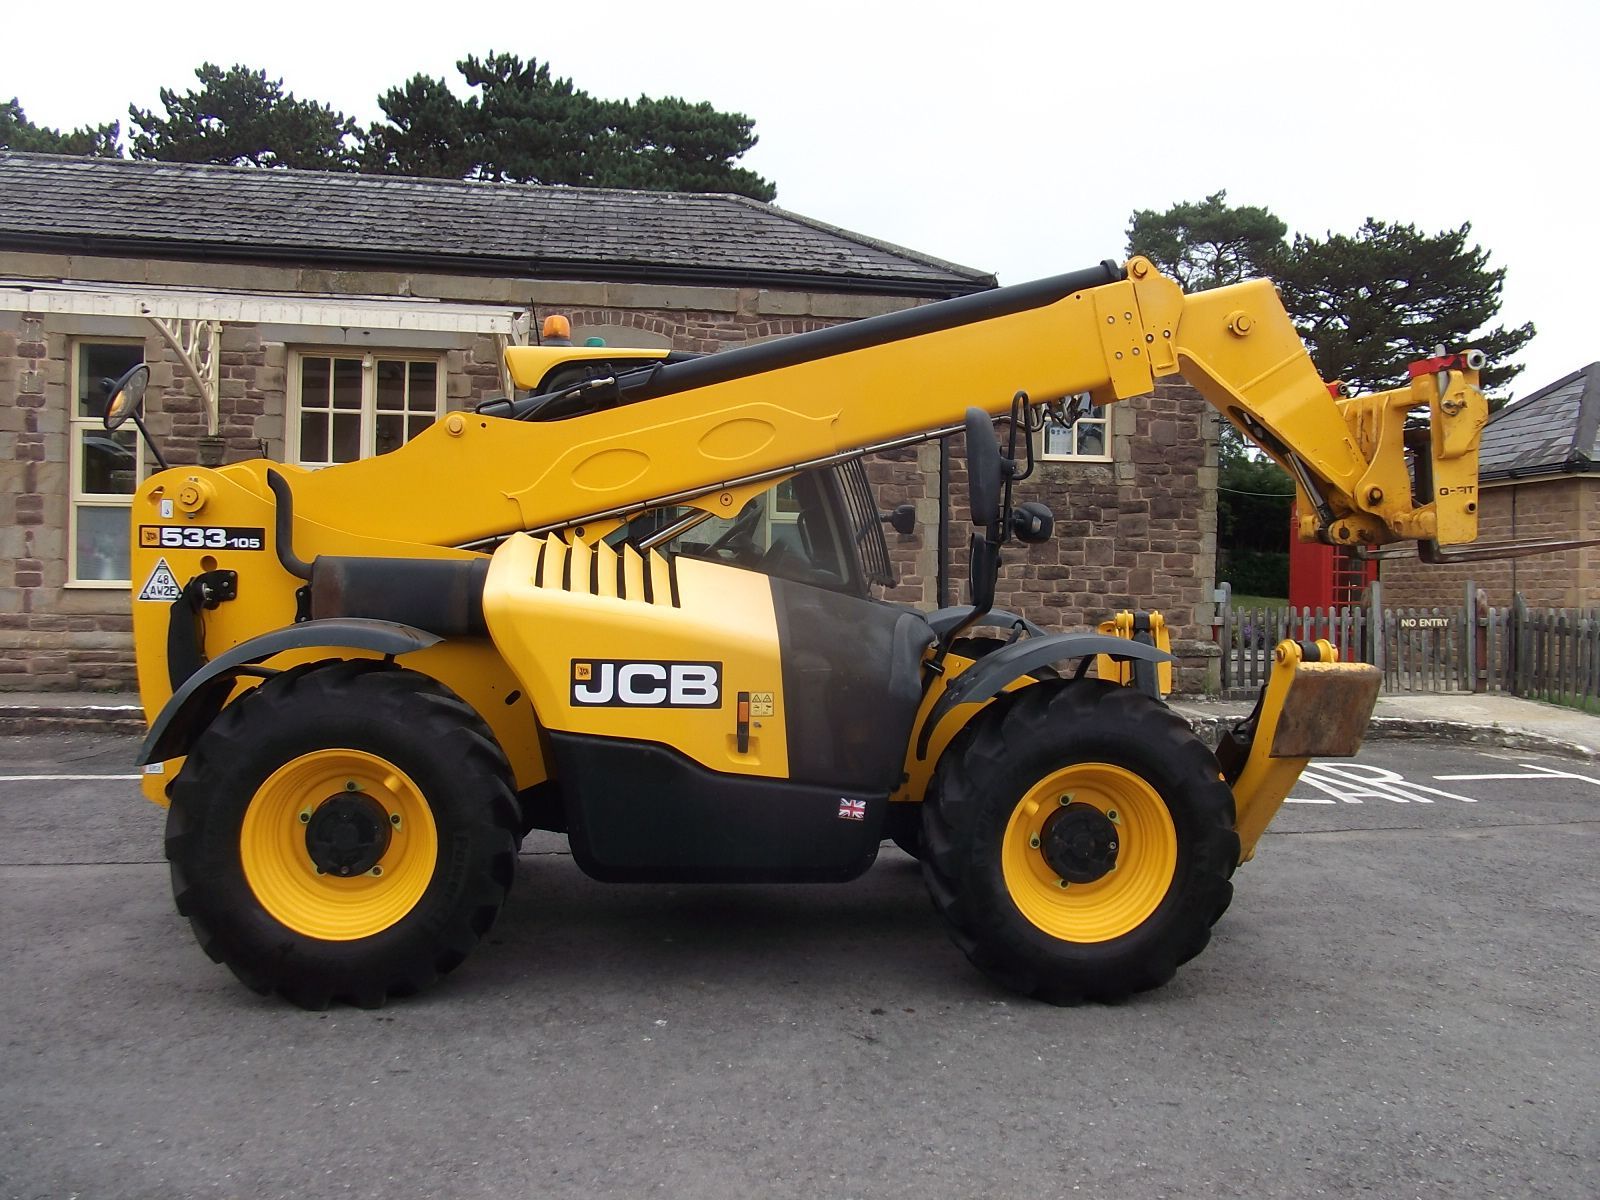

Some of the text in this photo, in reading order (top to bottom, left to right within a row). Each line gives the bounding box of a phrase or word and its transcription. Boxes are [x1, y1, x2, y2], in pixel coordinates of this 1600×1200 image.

[161, 527, 260, 549] 533-105
[157, 574, 169, 585] 48
[1401, 618, 1449, 627] NO ENTRY
[575, 663, 719, 705] JCB
